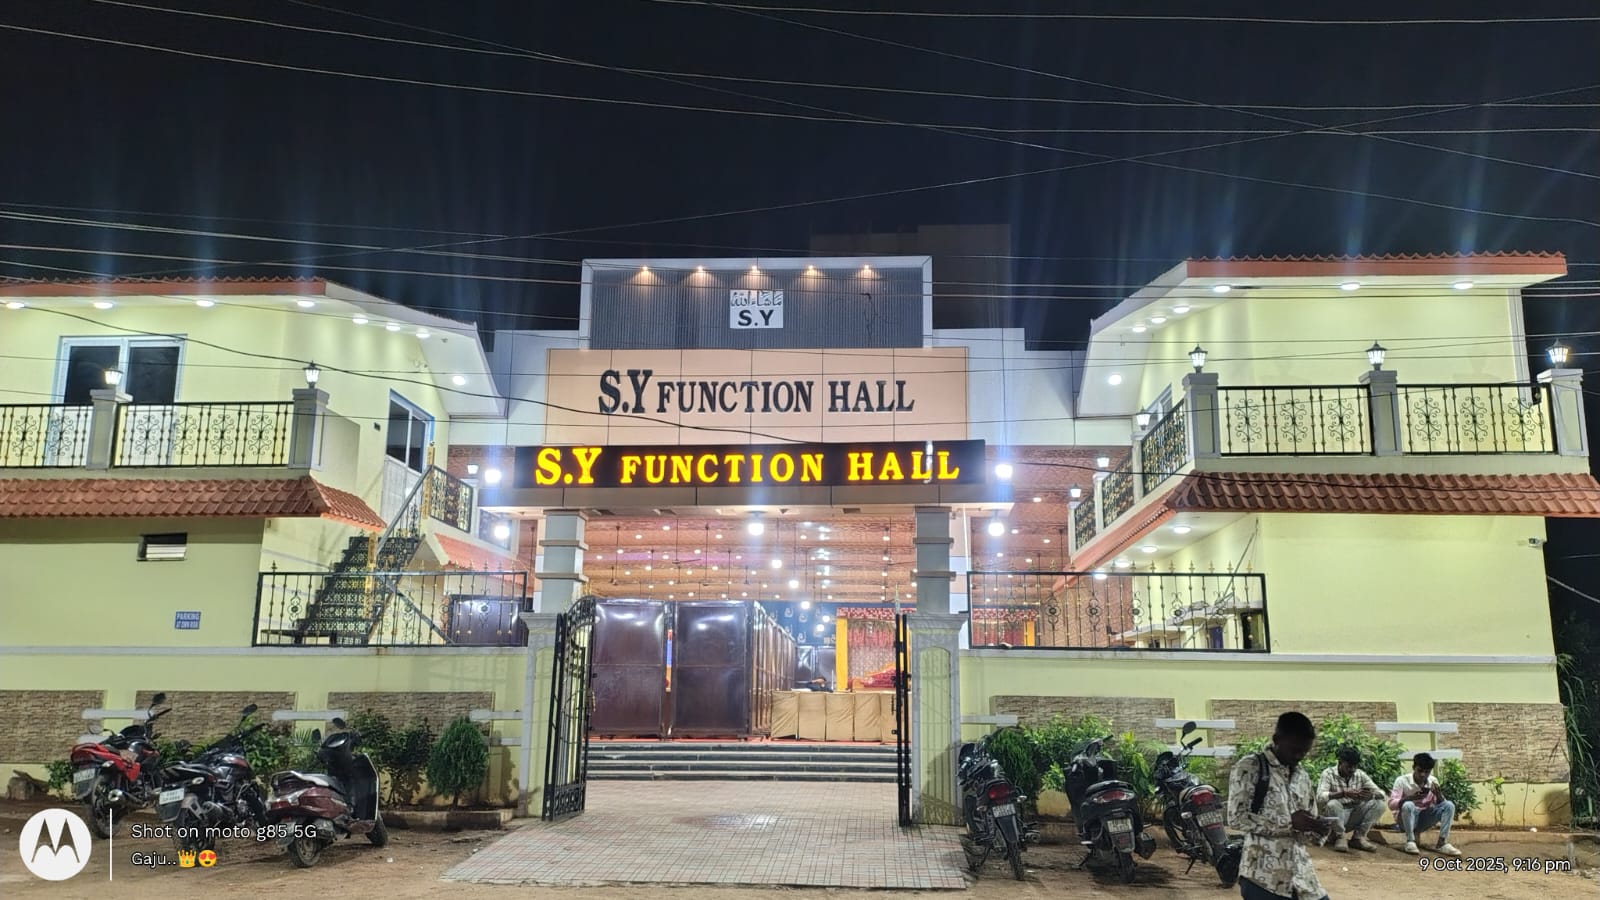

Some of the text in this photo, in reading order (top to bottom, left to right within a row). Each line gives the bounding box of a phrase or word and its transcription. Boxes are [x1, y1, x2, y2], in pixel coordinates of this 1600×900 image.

[738, 309, 774, 326] S.Y
[598, 369, 915, 413] S.Y FUNCTION HALL
[535, 447, 960, 485] S.Y FUNCTION HALL
[176, 612, 199, 620] PARKING
